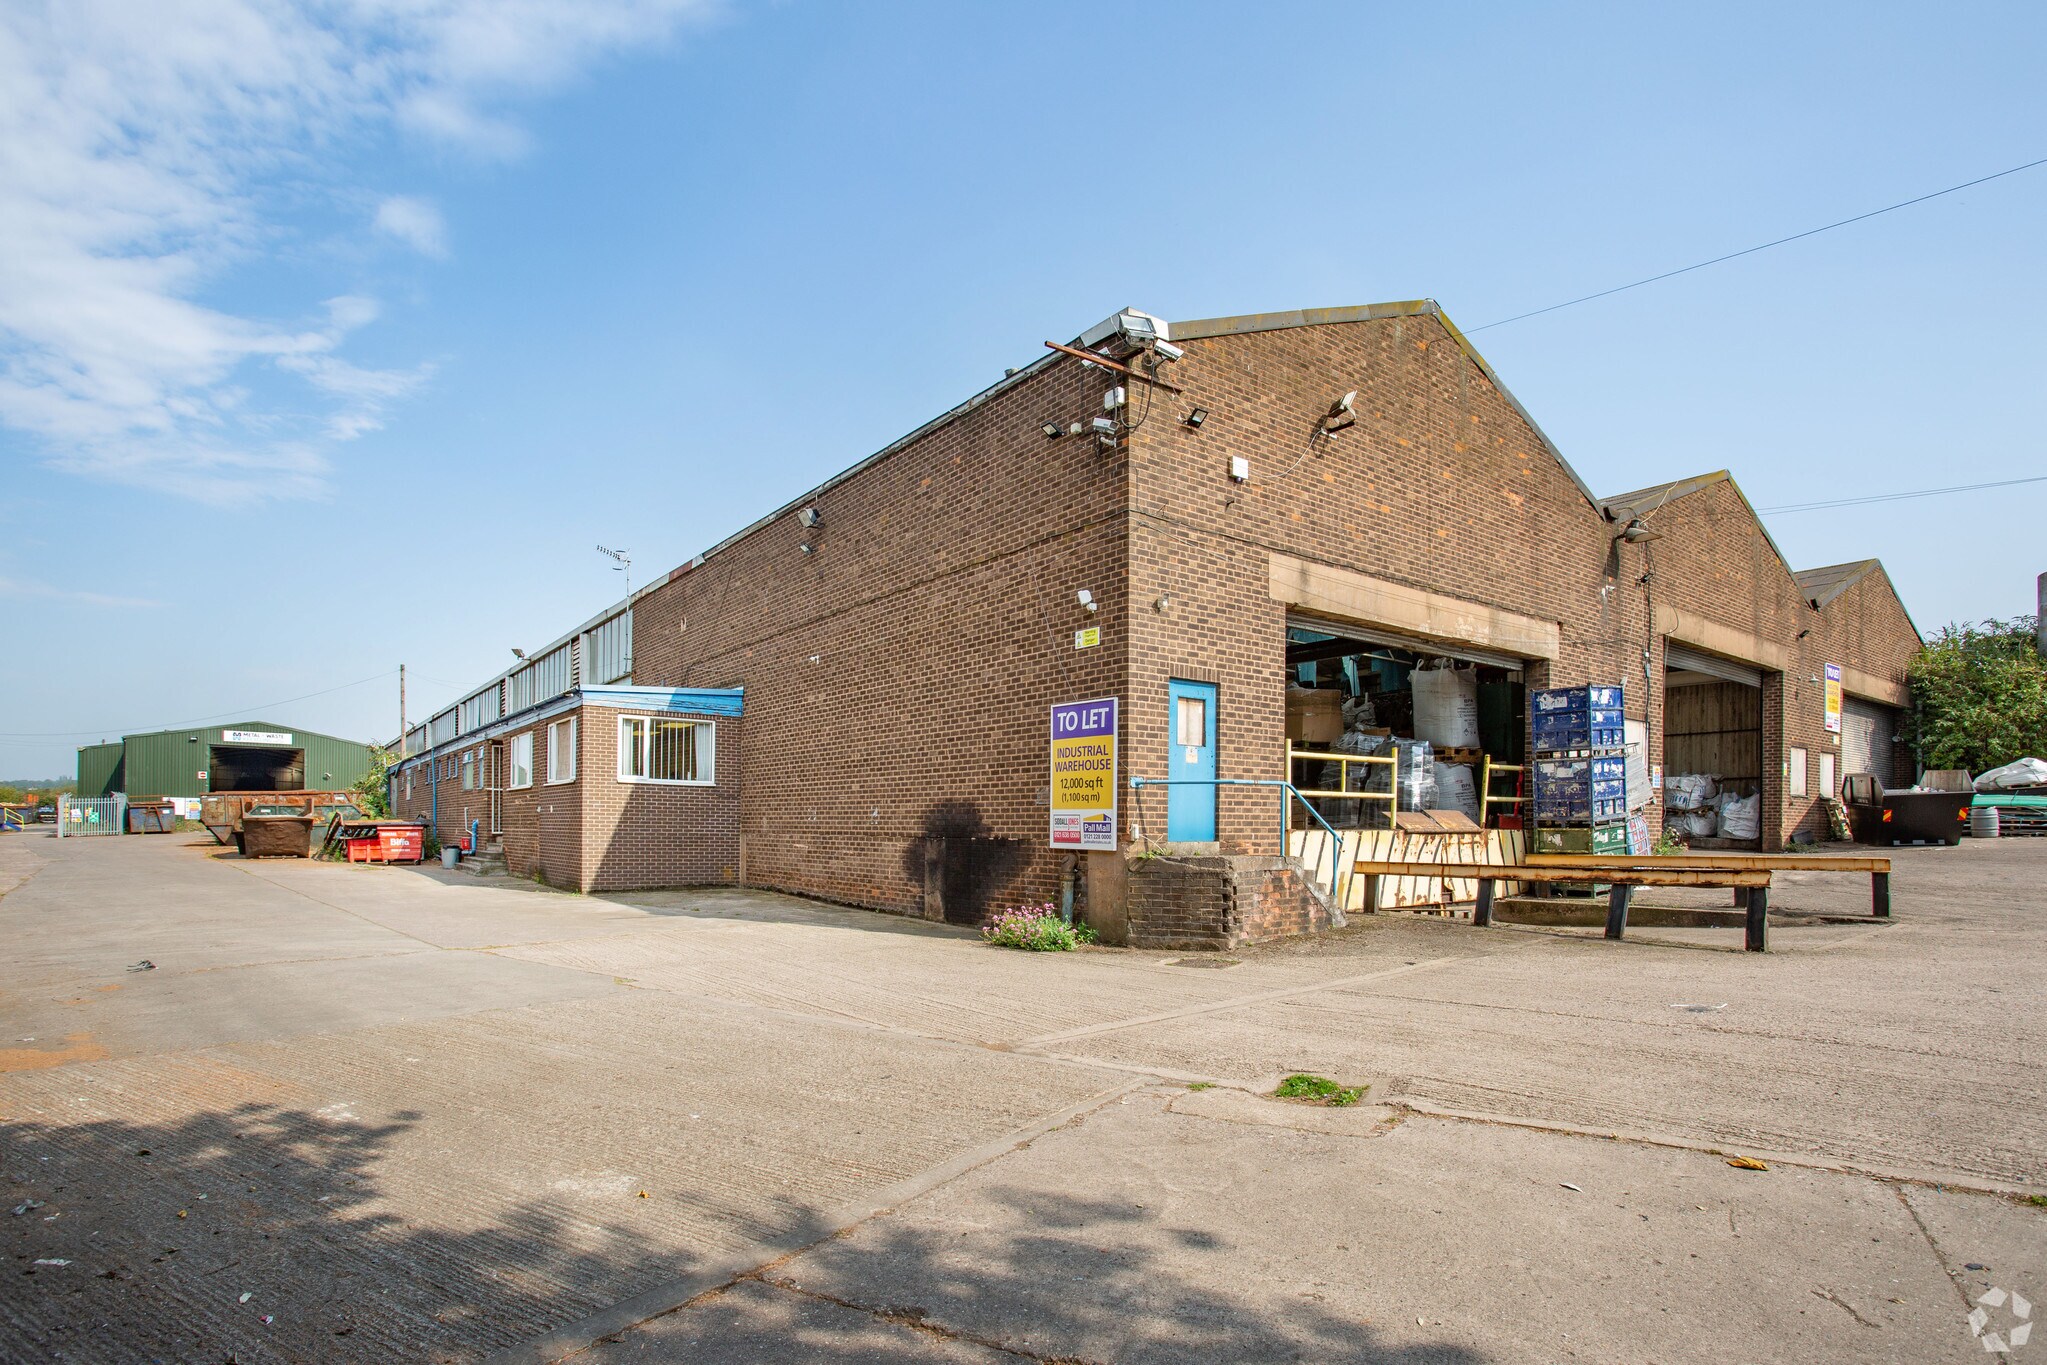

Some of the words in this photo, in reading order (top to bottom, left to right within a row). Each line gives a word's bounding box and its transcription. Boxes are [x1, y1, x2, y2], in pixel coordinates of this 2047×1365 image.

[1057, 711, 1078, 731] TO
[1082, 707, 1109, 729] LET
[1057, 745, 1108, 758] INDUSTRIAL
[1055, 759, 1111, 772] WAREHOUSE
[1060, 777, 1083, 790] 12,000
[1085, 780, 1094, 791] sq
[1096, 776, 1103, 788] ft
[1062, 792, 1080, 803] (1,100
[1081, 794, 1089, 803] sq
[1091, 792, 1100, 803] m)
[1084, 823, 1095, 832] Pall
[1096, 823, 1110, 832] Mall
[390, 838, 410, 846] Biffa
